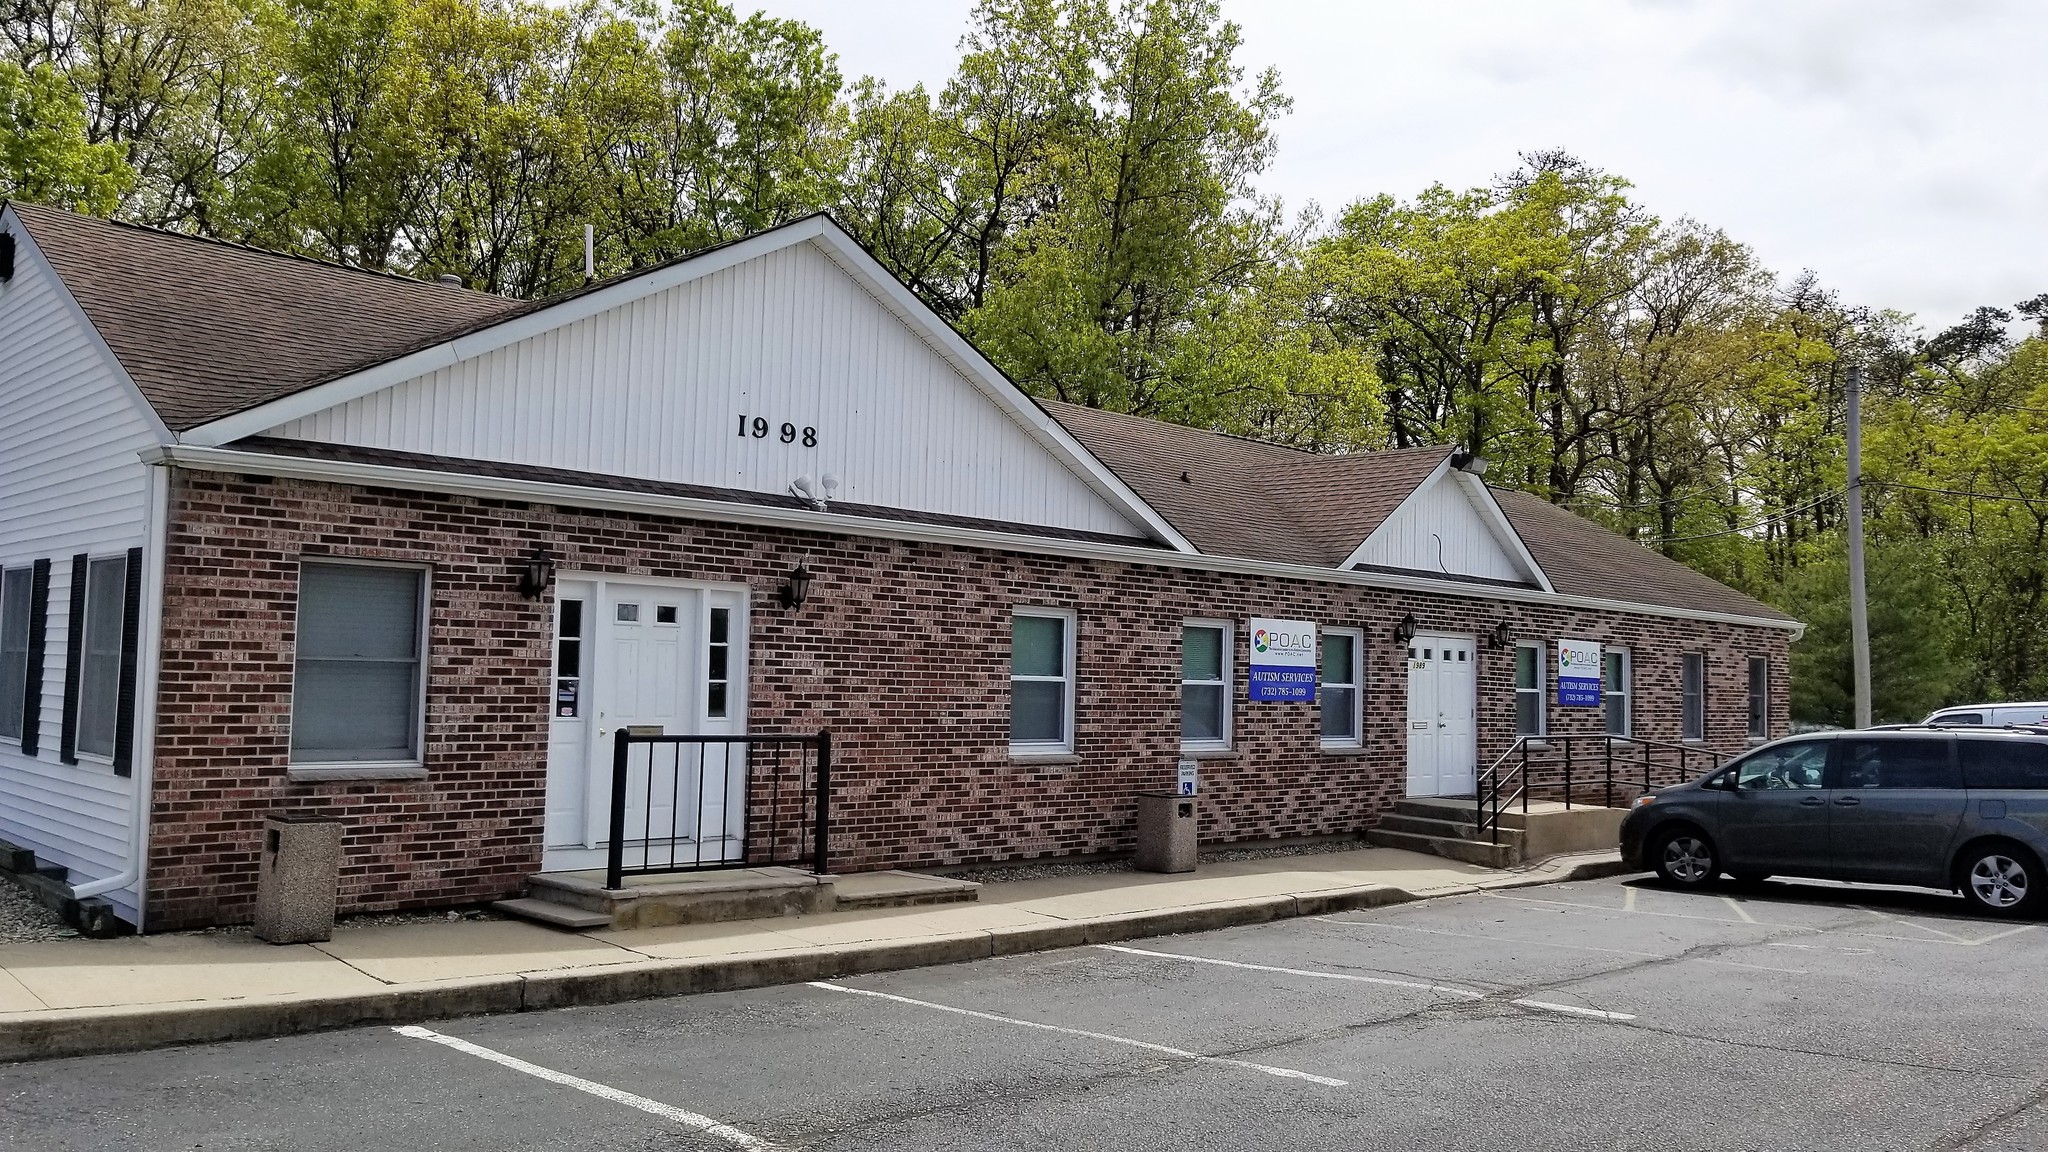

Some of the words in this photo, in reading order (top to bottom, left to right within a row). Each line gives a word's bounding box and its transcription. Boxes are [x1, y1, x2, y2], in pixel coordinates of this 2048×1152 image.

[738, 414, 817, 448] 1998
[1269, 632, 1312, 649] POAC
[1570, 650, 1598, 664] POAC
[1252, 671, 1281, 682] AUTISM
[1280, 672, 1314, 683] SERVICES
[1261, 687, 1277, 697] (732)
[1278, 687, 1307, 696] 785-1099
[1560, 681, 1578, 690] AUTISM
[1578, 682, 1599, 691] SERVICES
